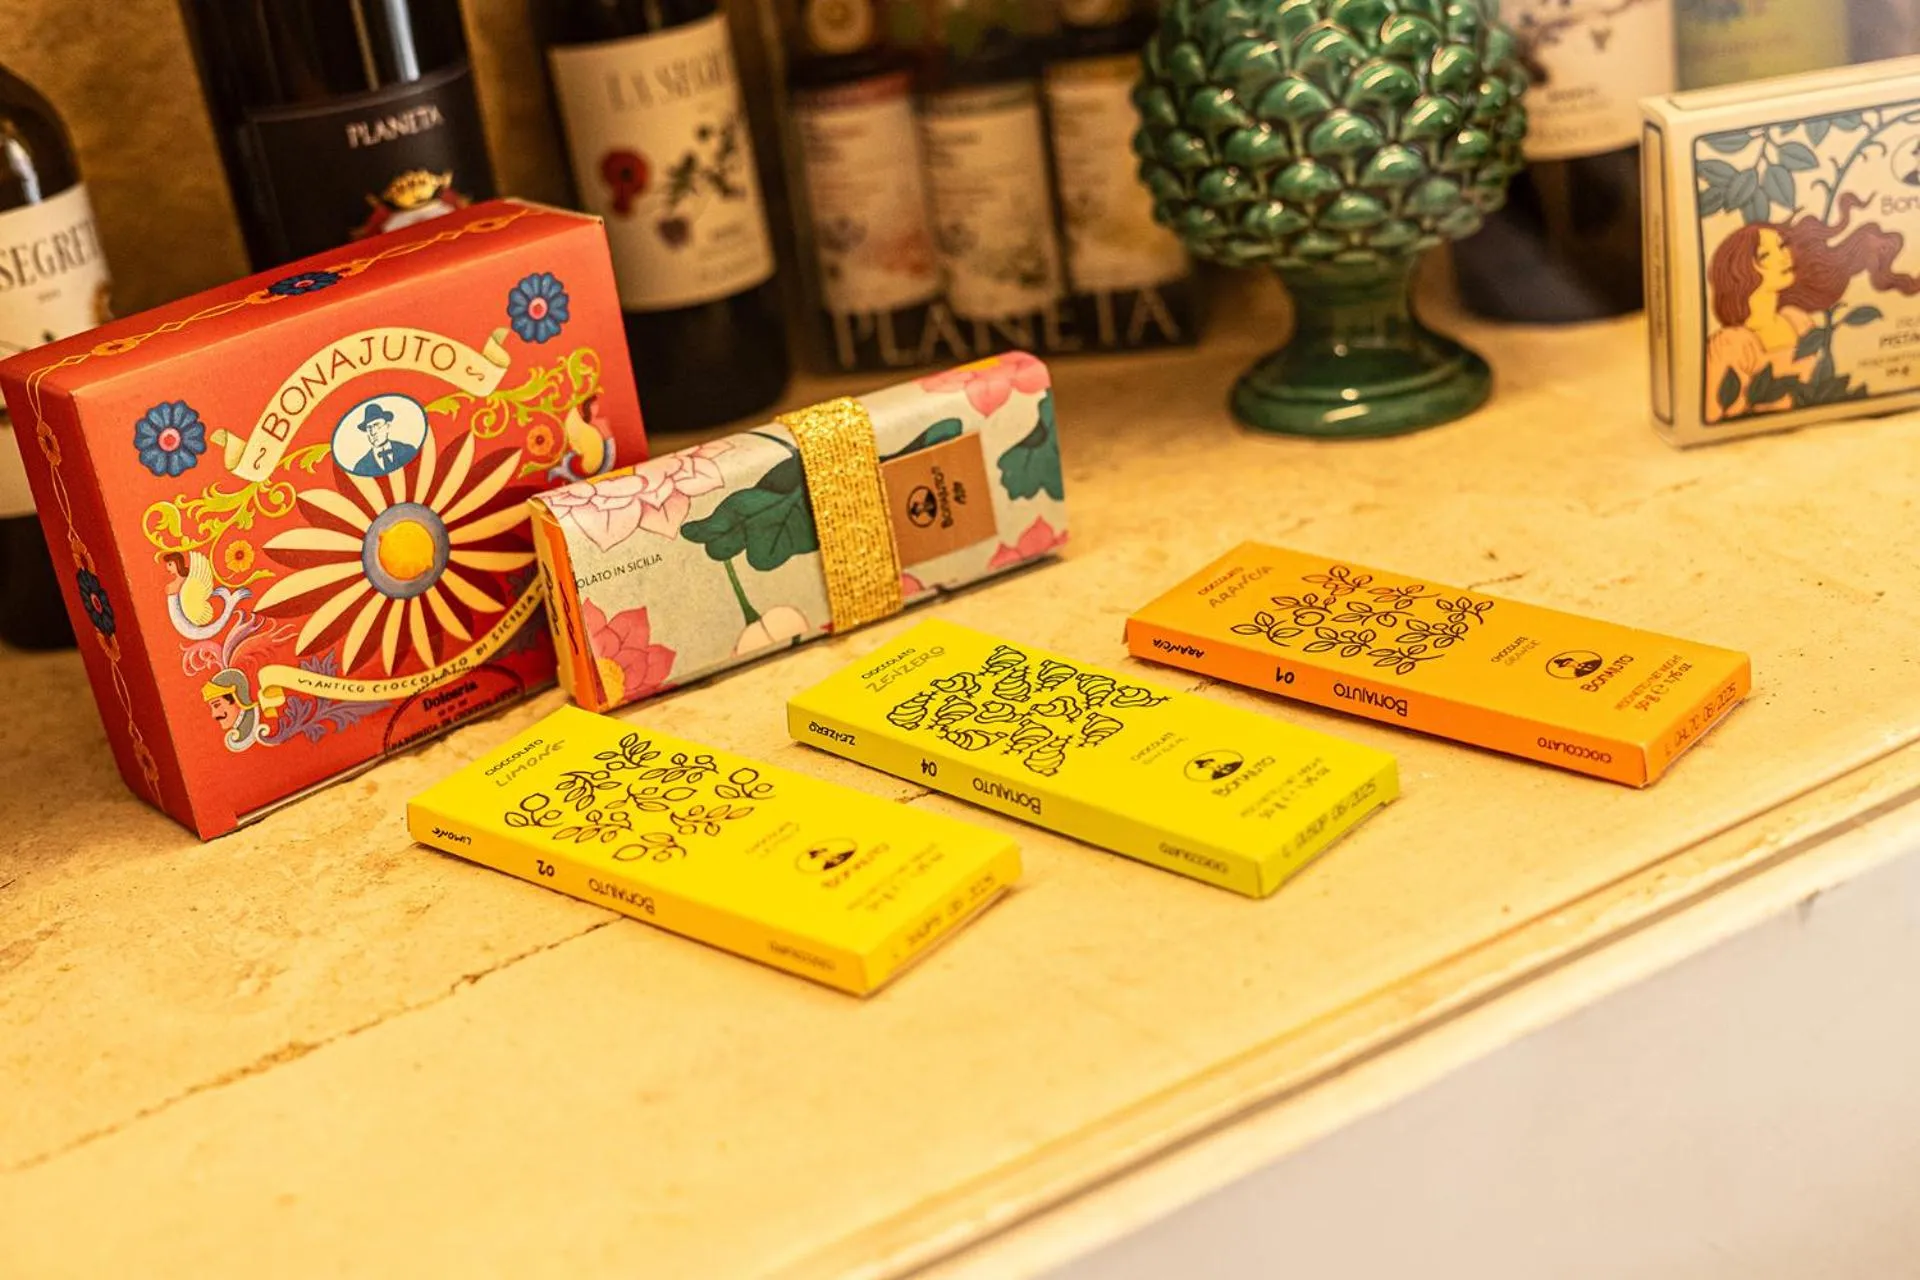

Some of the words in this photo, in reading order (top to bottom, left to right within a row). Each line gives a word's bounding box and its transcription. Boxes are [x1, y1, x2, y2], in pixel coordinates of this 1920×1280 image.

[346, 106, 444, 149] PLANETA
[832, 287, 1180, 371] PLANETA
[261, 335, 456, 442] BONAJUTO
[613, 564, 626, 577] IN
[627, 553, 663, 573] SICILIA
[1208, 565, 1275, 609] ARANCIA
[314, 680, 365, 693] ANTICO
[373, 658, 469, 694] CIOCCOLATO
[475, 642, 488, 656] DI
[492, 595, 534, 642] SICILIA
[1151, 637, 1205, 659] ARANCIA
[861, 647, 916, 680] CIOCCOLATO
[865, 646, 945, 693] ZENZERO
[1275, 666, 1295, 685] 01
[1333, 682, 1408, 716] BONAJUTO
[808, 720, 855, 746] ZENZERO
[1537, 736, 1612, 764] CIOCCOLATO
[484, 738, 544, 776] CIOCCOLATO
[495, 739, 566, 787] LIMONE
[920, 758, 937, 777] 04
[972, 777, 1042, 815] BONAJUTO
[431, 826, 472, 846] LIMONE
[535, 859, 556, 877] 02
[588, 878, 656, 915] BONAJUTO
